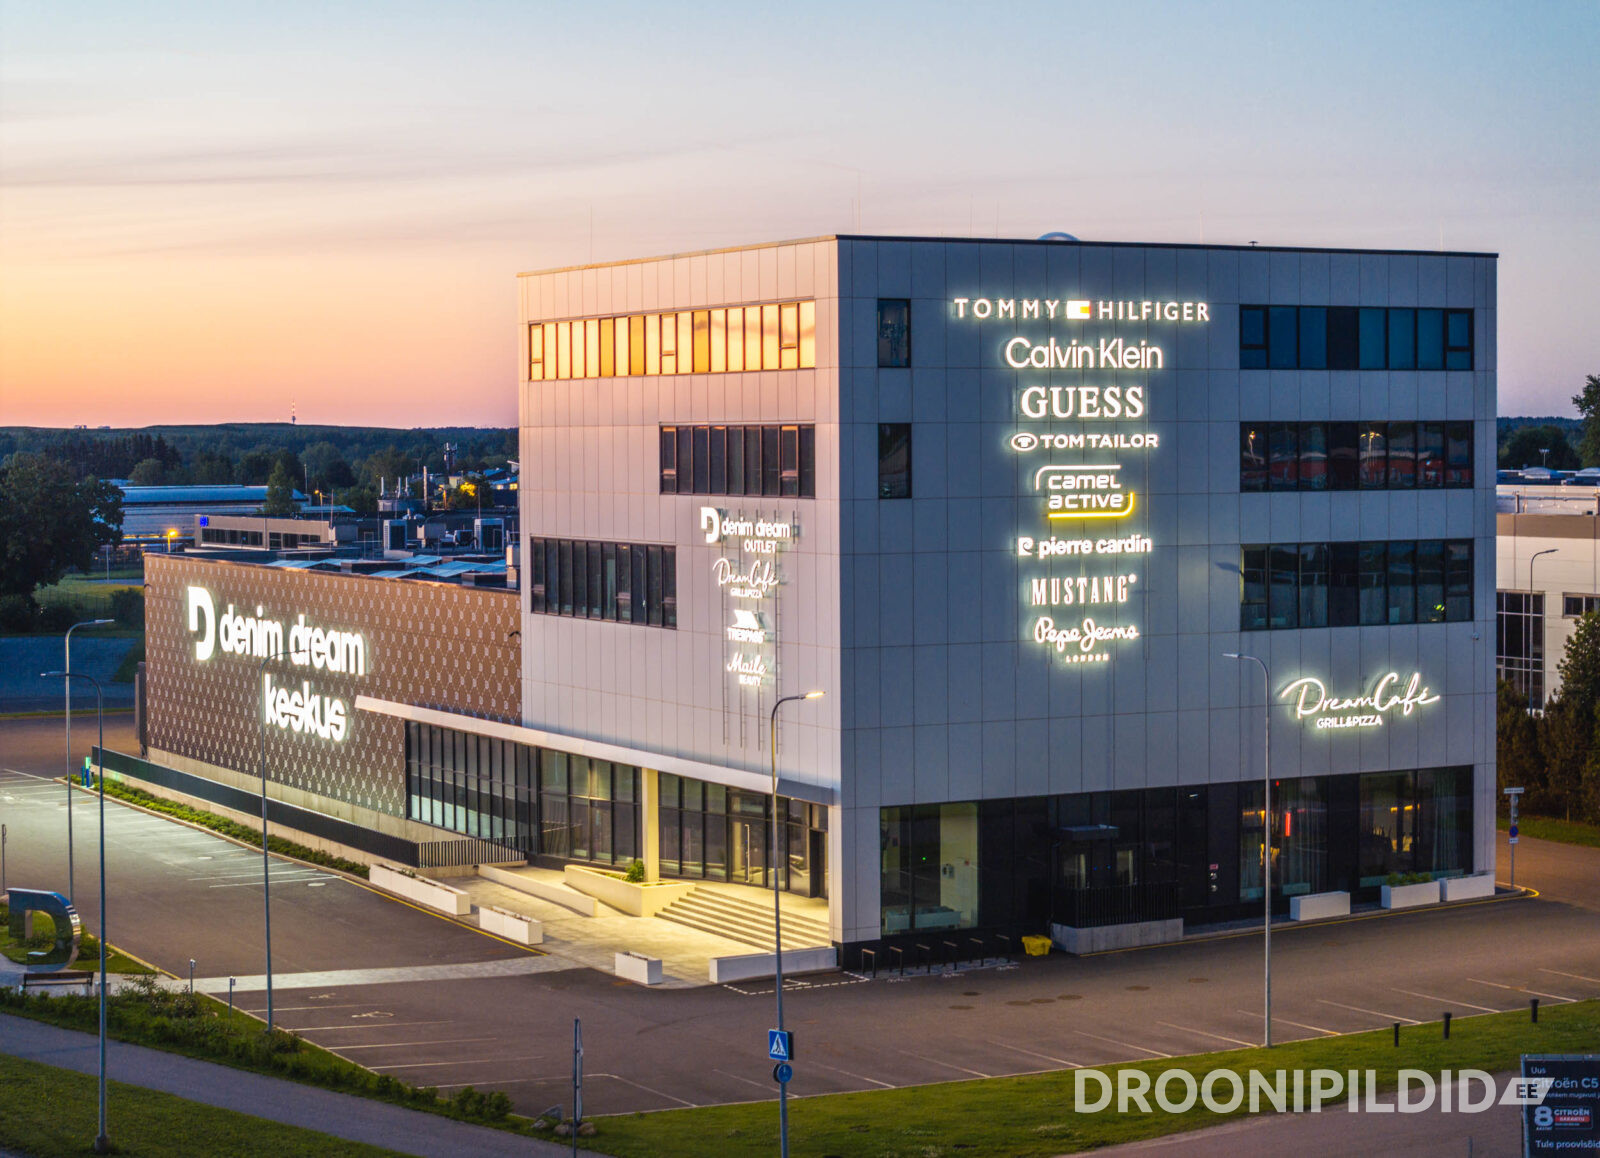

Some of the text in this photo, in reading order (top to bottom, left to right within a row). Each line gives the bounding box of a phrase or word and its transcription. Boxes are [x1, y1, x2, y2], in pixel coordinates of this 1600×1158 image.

[955, 299, 1209, 321] TOMMY HILFIGER
[1005, 336, 1163, 369] Calvin Klein
[1021, 386, 1144, 418] GUESS
[1040, 433, 1159, 449] TOM TAILOR
[721, 517, 754, 537] denim
[755, 519, 791, 538] dream
[743, 539, 777, 554] OUTLET
[1038, 534, 1152, 560] pierre cardin
[219, 603, 284, 662] denim
[289, 613, 366, 676] dream
[1035, 616, 1140, 652] Pepe Jeans
[264, 673, 348, 743] keskus
[1531, 1066, 1546, 1074] Uus
[1581, 1077, 1599, 1089] C5
[1534, 1105, 1554, 1127] 8
[1535, 1140, 1554, 1148] Tule
